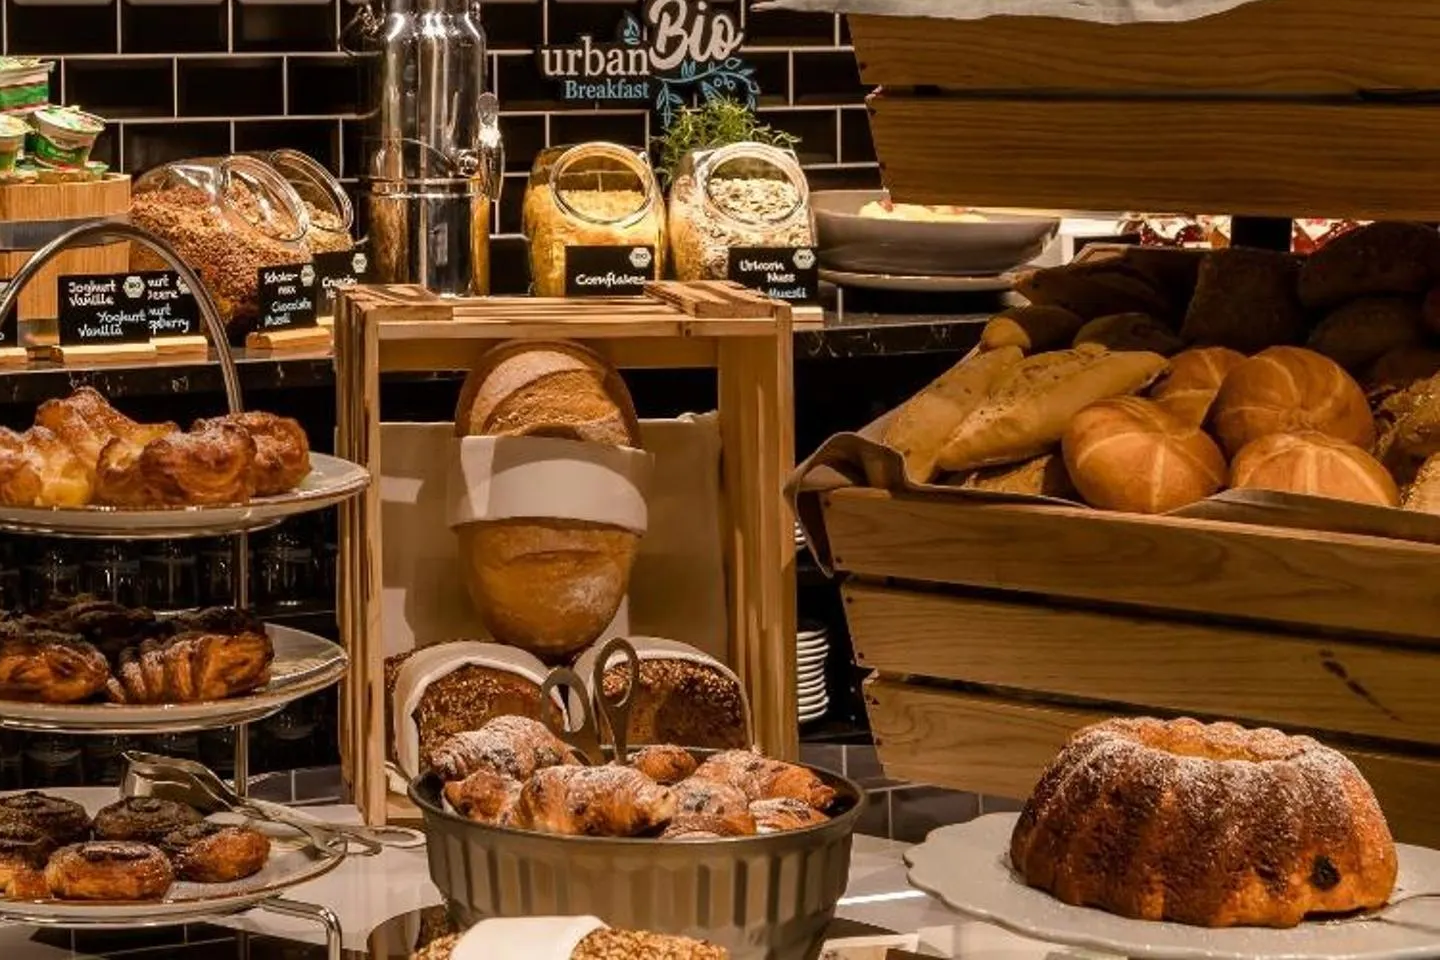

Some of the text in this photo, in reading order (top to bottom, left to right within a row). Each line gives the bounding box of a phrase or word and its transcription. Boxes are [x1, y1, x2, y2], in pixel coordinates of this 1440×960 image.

[541, 35, 650, 76] urban
[565, 79, 649, 100] Breakfast
[575, 270, 646, 289] Cornflakes
